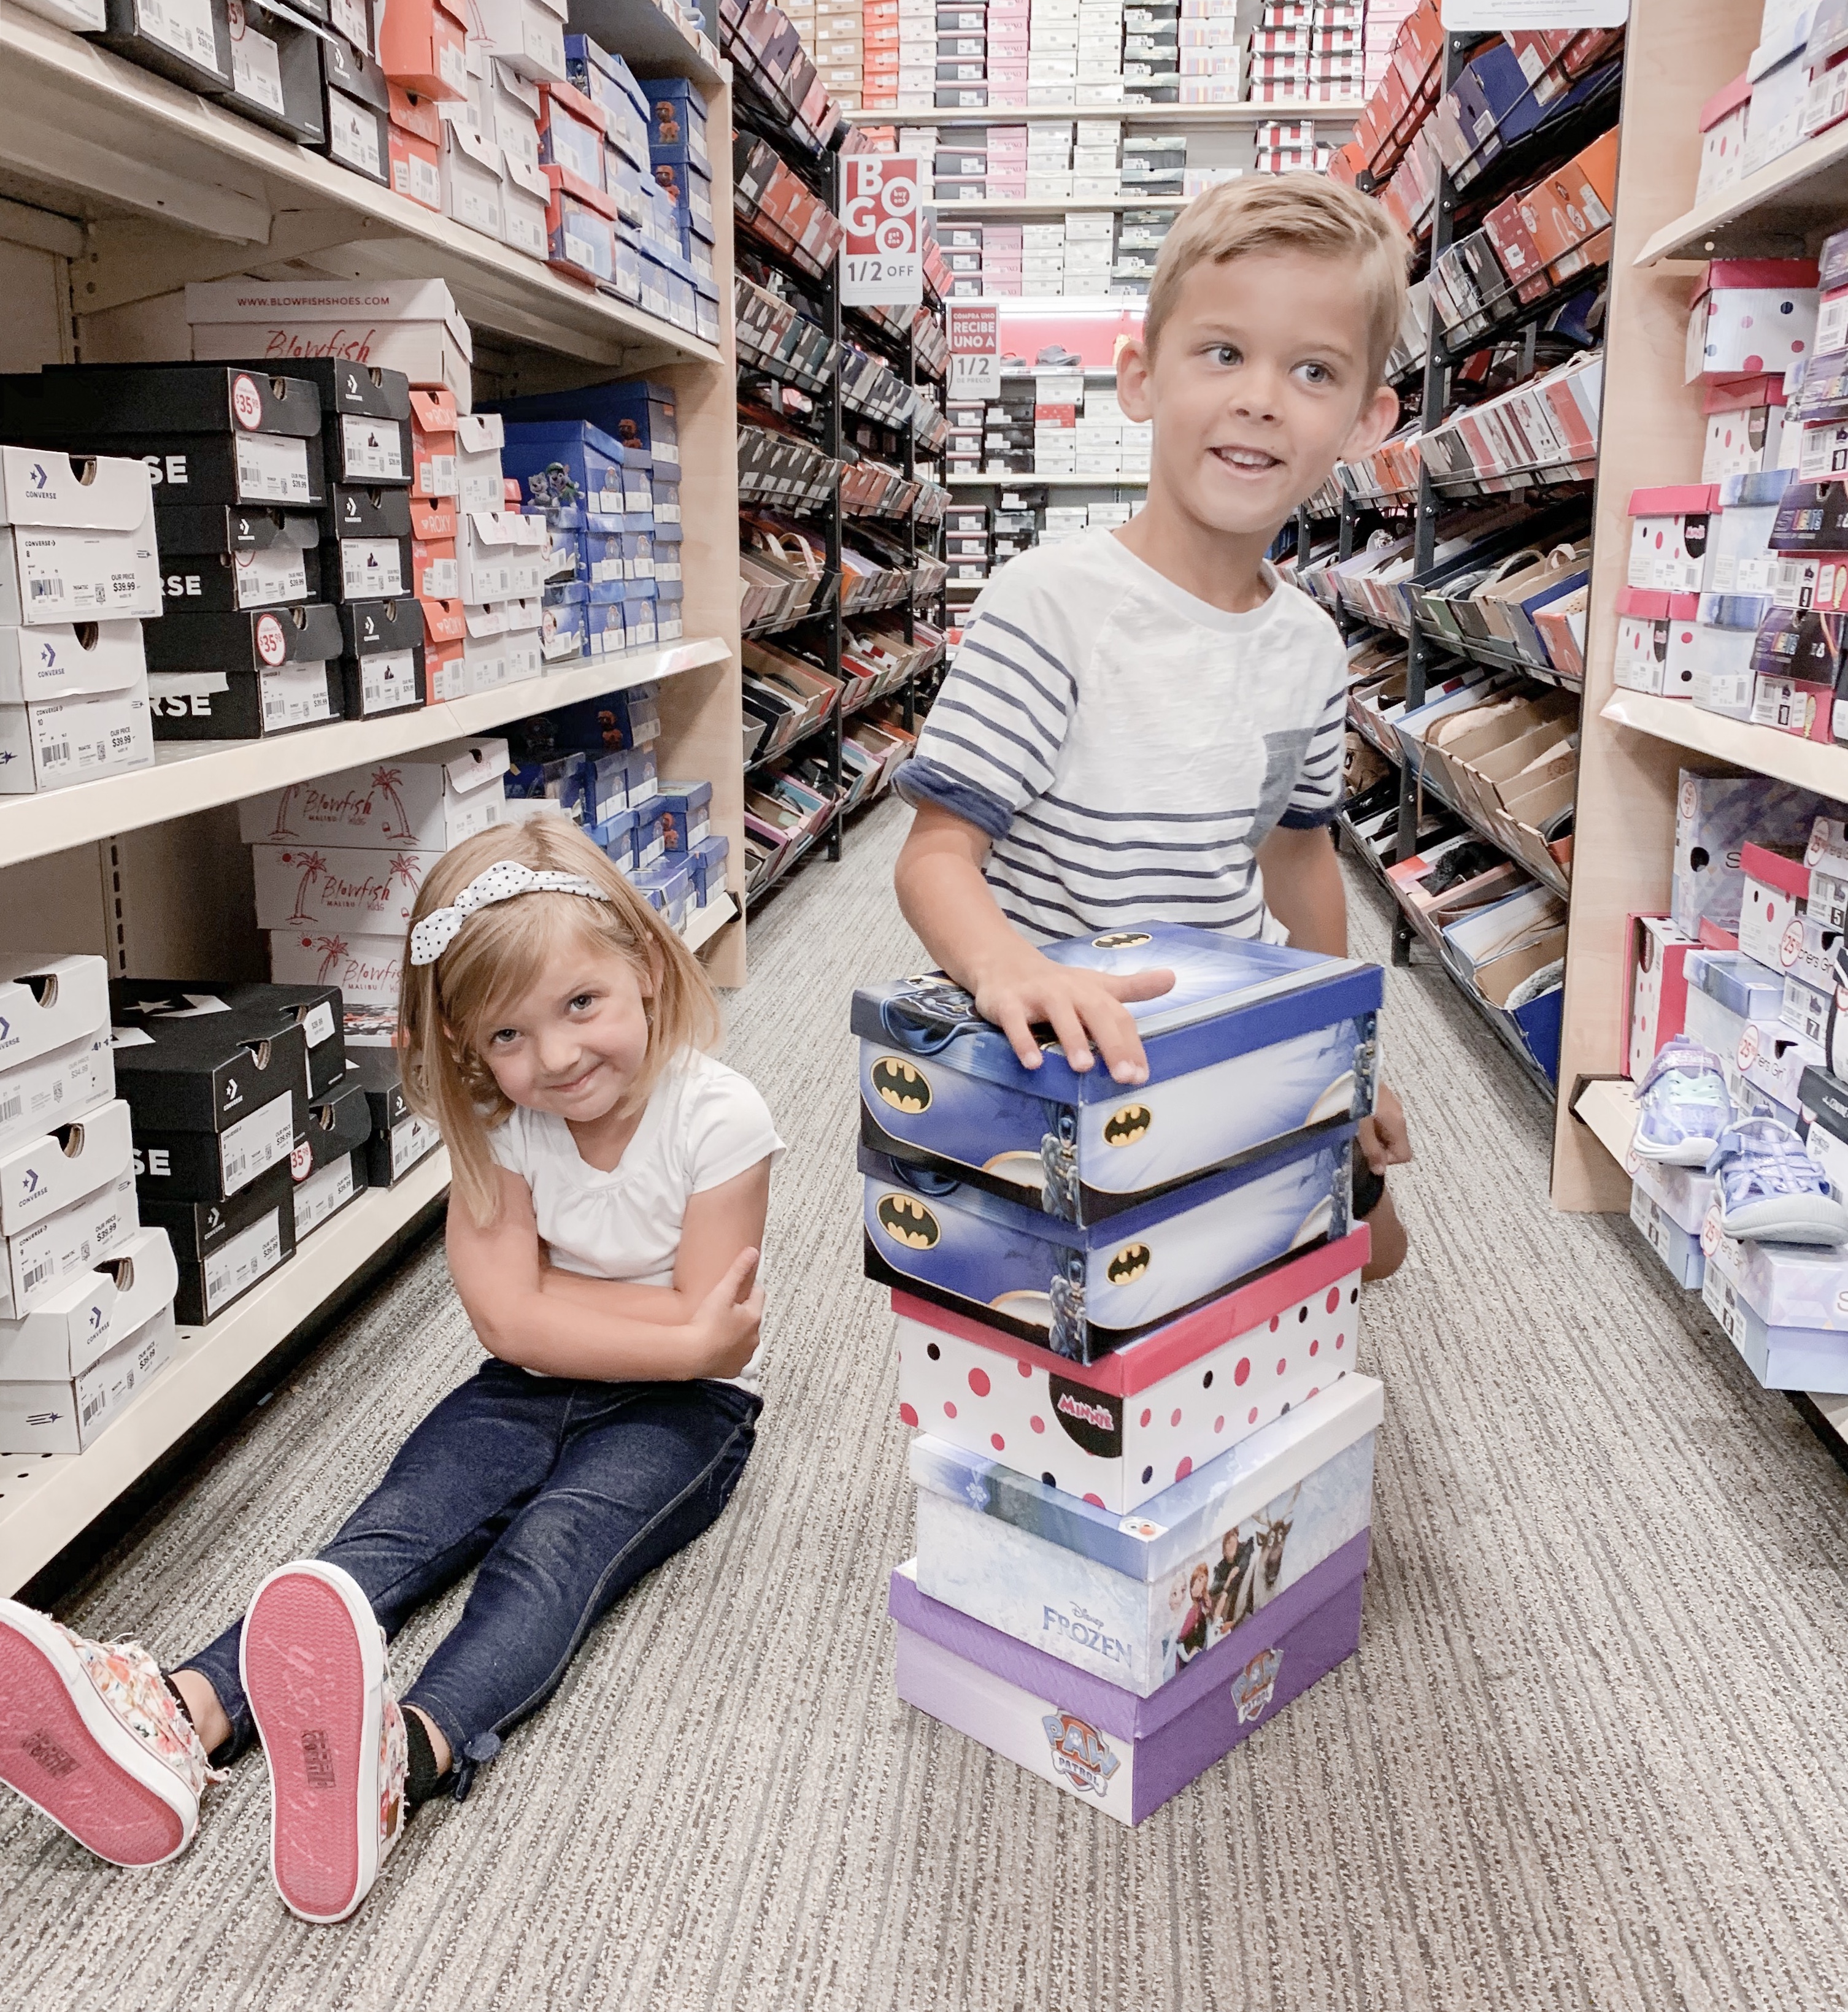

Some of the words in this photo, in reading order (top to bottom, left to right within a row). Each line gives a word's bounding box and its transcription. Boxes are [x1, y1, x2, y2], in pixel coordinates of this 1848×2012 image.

[848, 261, 882, 282] 1/2
[887, 265, 914, 277] OFF
[237, 296, 390, 307] WWW.BLOWFISHSHOES.COM
[953, 321, 995, 333] RECIBE
[266, 329, 375, 363] Blowfish
[953, 336, 983, 347] UNO
[985, 336, 995, 347] A
[958, 357, 989, 375] 1/2
[25, 491, 56, 499] CONVERSE
[429, 515, 451, 533] ROXY
[113, 582, 136, 592] $39.99
[37, 668, 66, 678] CONVERSE
[120, 727, 131, 735] PRICE
[112, 735, 131, 748] $39.99
[303, 790, 375, 821] Blowfish
[321, 875, 393, 907] Blowfish
[18, 1186, 48, 1208] CONVERSE
[105, 1214, 117, 1228] PRICE
[96, 1223, 117, 1243] $39.99
[87, 1321, 110, 1345] CONVERSE
[1069, 1601, 1104, 1630] Disney
[1043, 1605, 1132, 1670] FROZEN
[1042, 1715, 1121, 1780] PAW
[1058, 1757, 1100, 1787] PATROL
